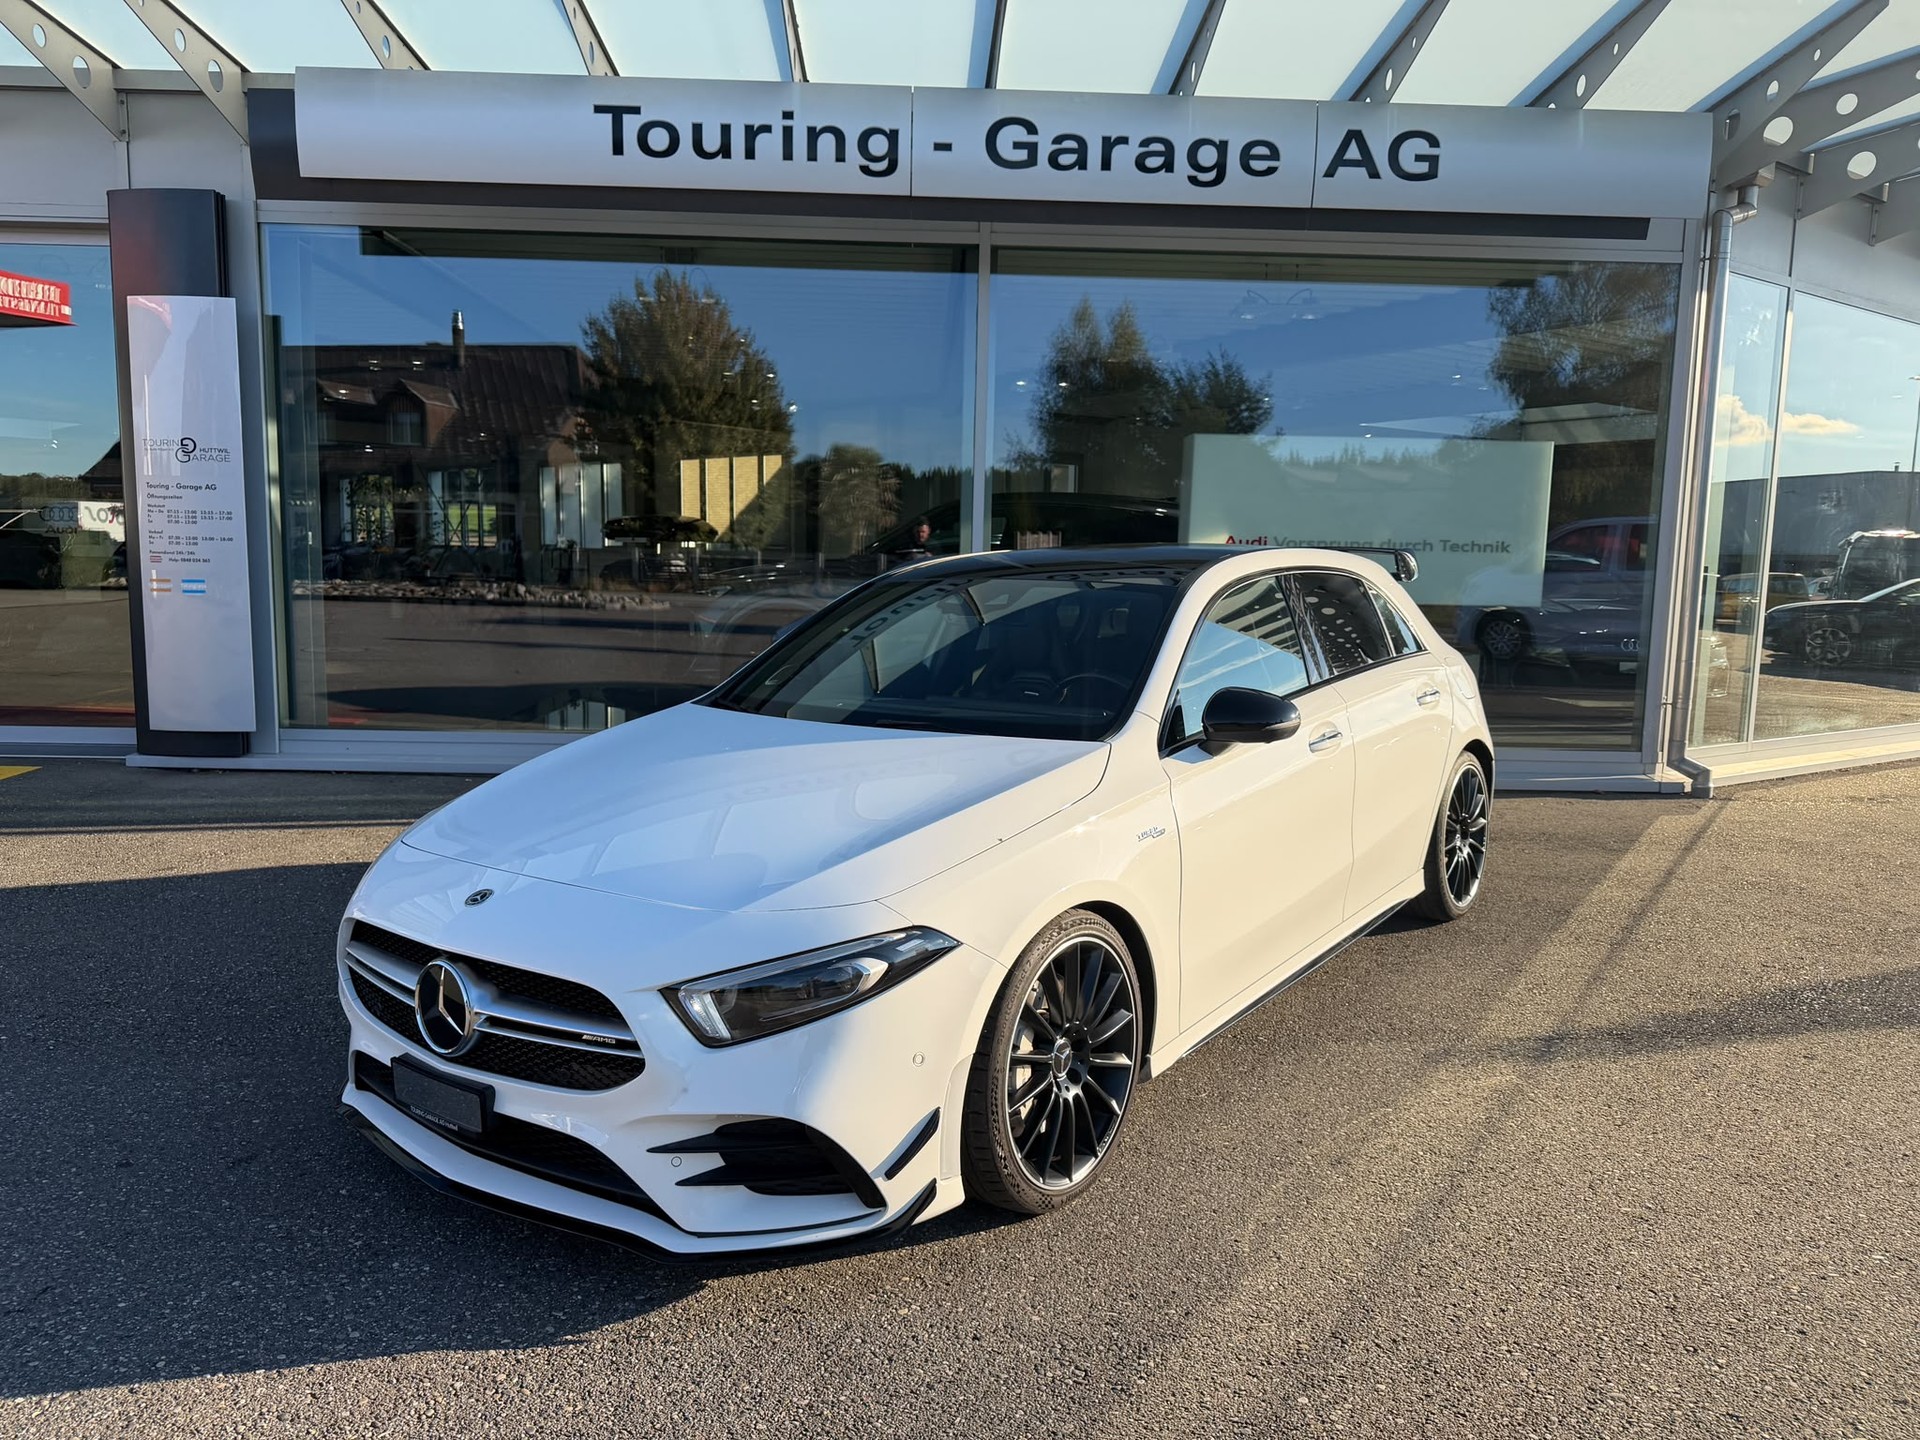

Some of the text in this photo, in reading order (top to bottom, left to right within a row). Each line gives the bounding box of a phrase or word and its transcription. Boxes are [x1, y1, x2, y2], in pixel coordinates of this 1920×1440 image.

[594, 105, 1441, 188] Touring - Garage AG
[146, 482, 170, 490] Touring
[176, 483, 203, 491] Garage
[1225, 535, 1268, 546] Audi
[1379, 538, 1433, 551] durch
[1439, 540, 1511, 553] Technik
[591, 1036, 616, 1044] AMG
